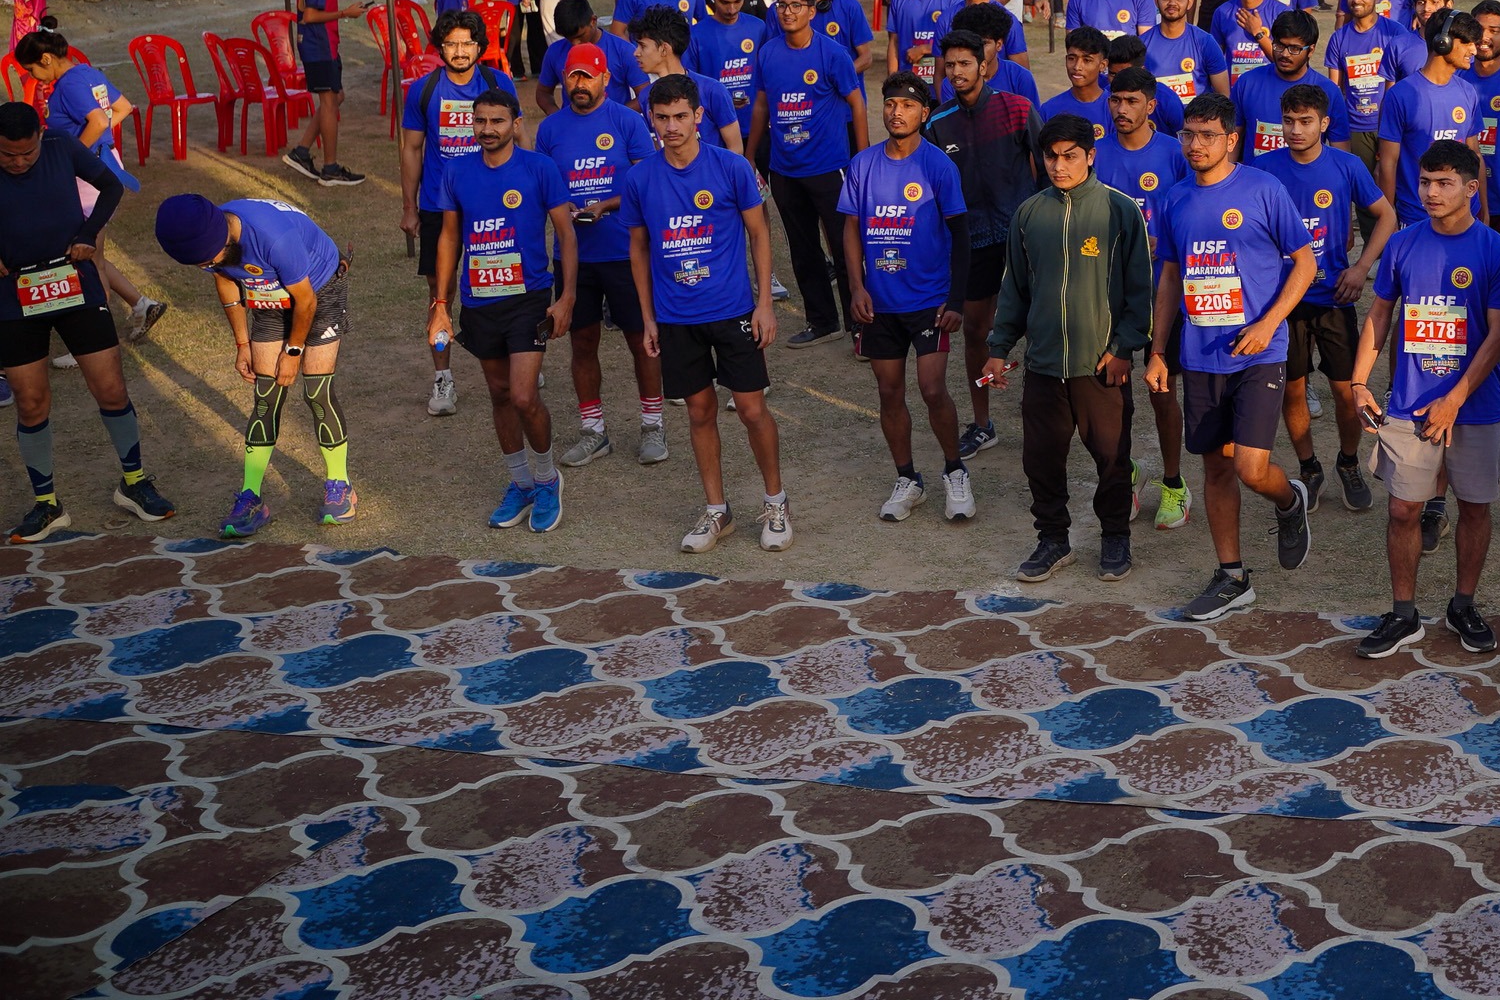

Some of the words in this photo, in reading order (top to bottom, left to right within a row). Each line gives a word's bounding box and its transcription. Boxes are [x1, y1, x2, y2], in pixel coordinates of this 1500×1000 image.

[914, 31, 935, 40] USF
[1237, 42, 1259, 52] USF
[724, 58, 748, 70] USF
[1353, 63, 1378, 76] 2201
[781, 93, 806, 104] USF
[449, 112, 476, 125] 213
[776, 109, 812, 118] MARATHON!
[1261, 135, 1288, 149] 213
[574, 156, 607, 171] USF
[568, 166, 609, 181] HALF
[568, 177, 613, 189] MARATHON!
[875, 204, 907, 218] USF
[473, 217, 506, 234] USF
[669, 215, 703, 230] USF
[867, 216, 909, 229] HALF
[1301, 217, 1320, 230] SF
[469, 228, 509, 245] HALF
[662, 227, 707, 242] HALF
[866, 227, 912, 237] MARATHON!
[469, 239, 515, 252] MARATHON!
[662, 237, 712, 250] MARATHON!
[1193, 240, 1227, 255] USF
[1186, 253, 1232, 267] HALF
[478, 268, 514, 284] 2143
[1186, 265, 1236, 276] MARATHON!
[29, 279, 71, 301] 2130
[1194, 294, 1233, 311] 2206
[1415, 321, 1456, 339] 2178
